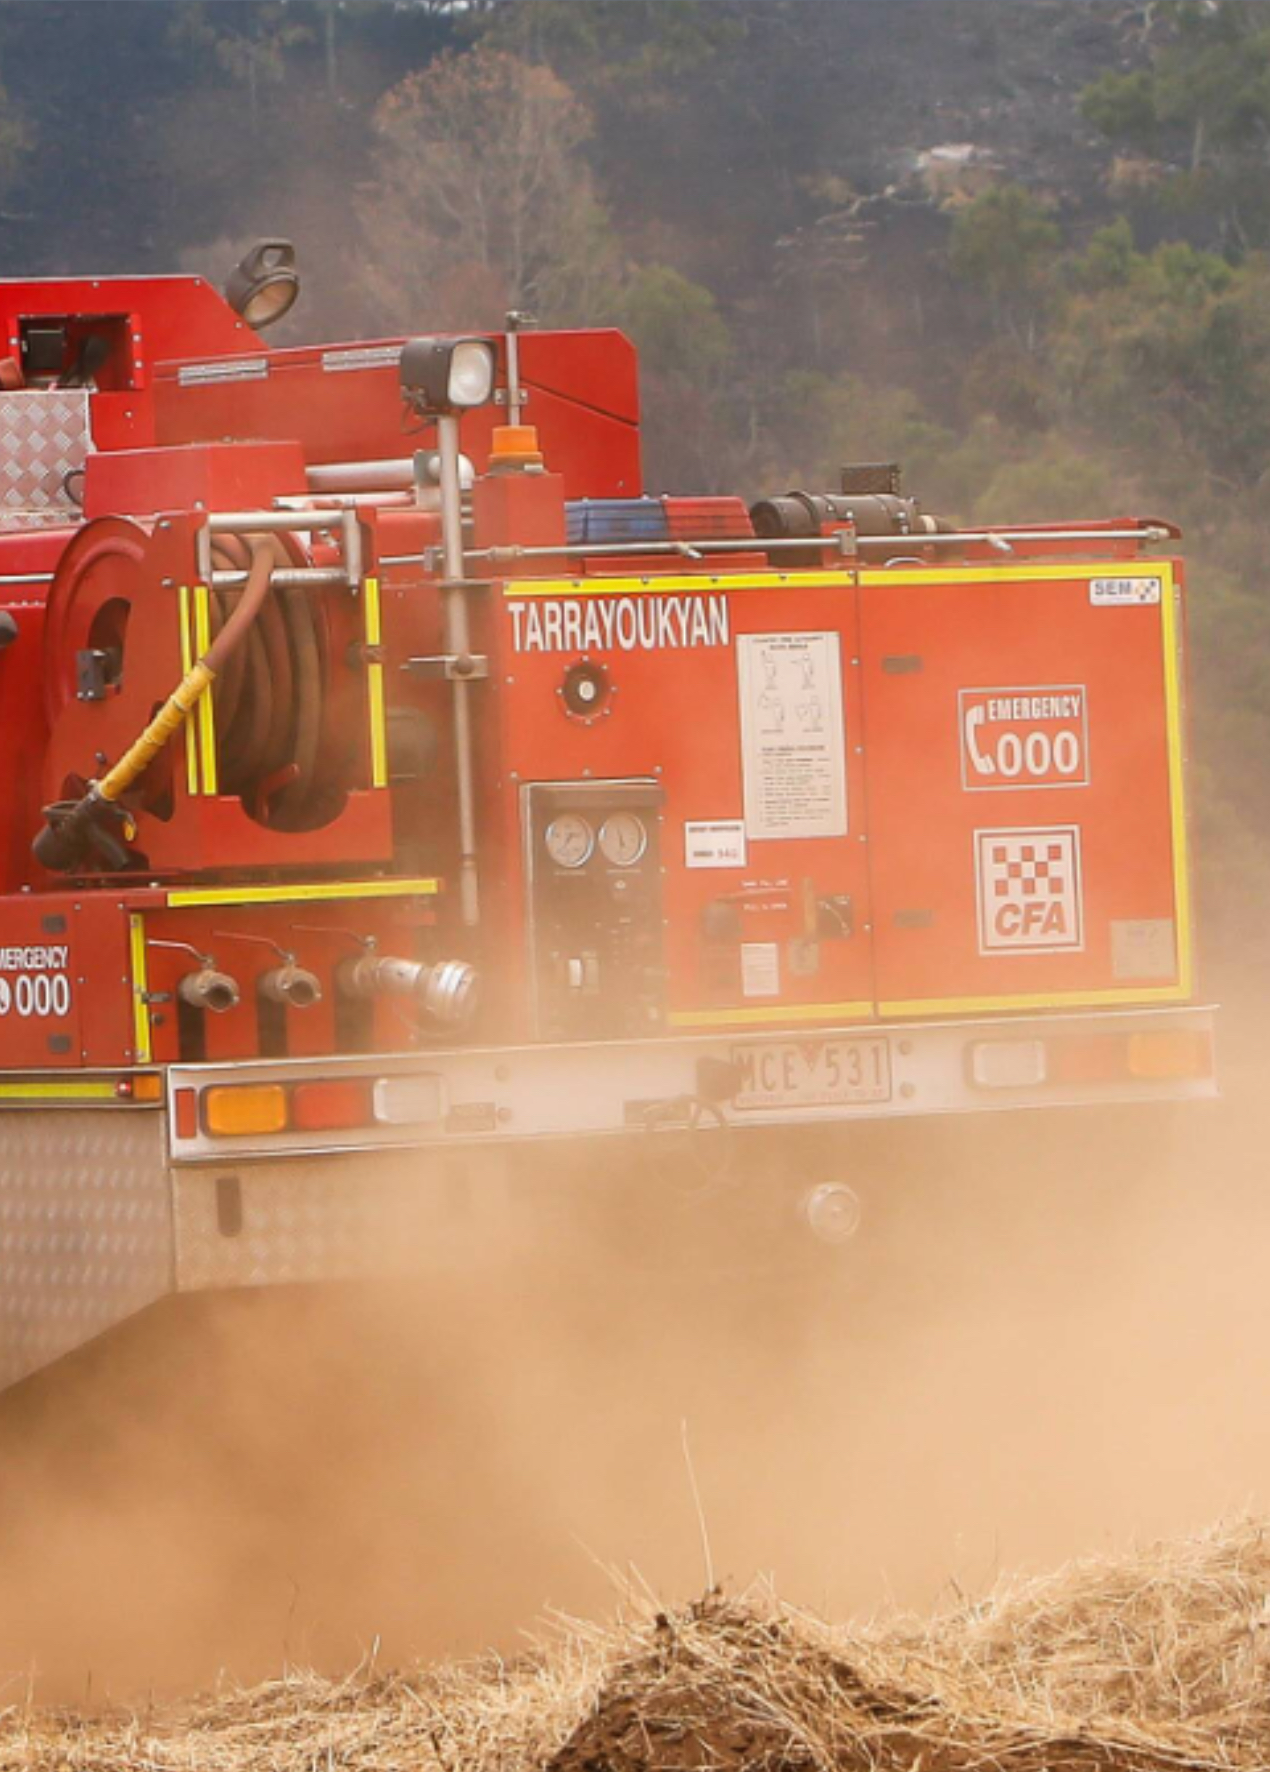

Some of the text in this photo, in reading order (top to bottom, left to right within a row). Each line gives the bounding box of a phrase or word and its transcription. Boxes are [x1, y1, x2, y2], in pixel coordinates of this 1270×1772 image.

[1094, 581, 1131, 596] SEM
[507, 594, 729, 653] TARRAYOUKYAN
[987, 694, 1080, 720] EMERGENCY
[996, 730, 1079, 777] 000
[994, 901, 1067, 936] CFA
[16, 973, 70, 1016] 000
[736, 1046, 881, 1091] MCE 531
